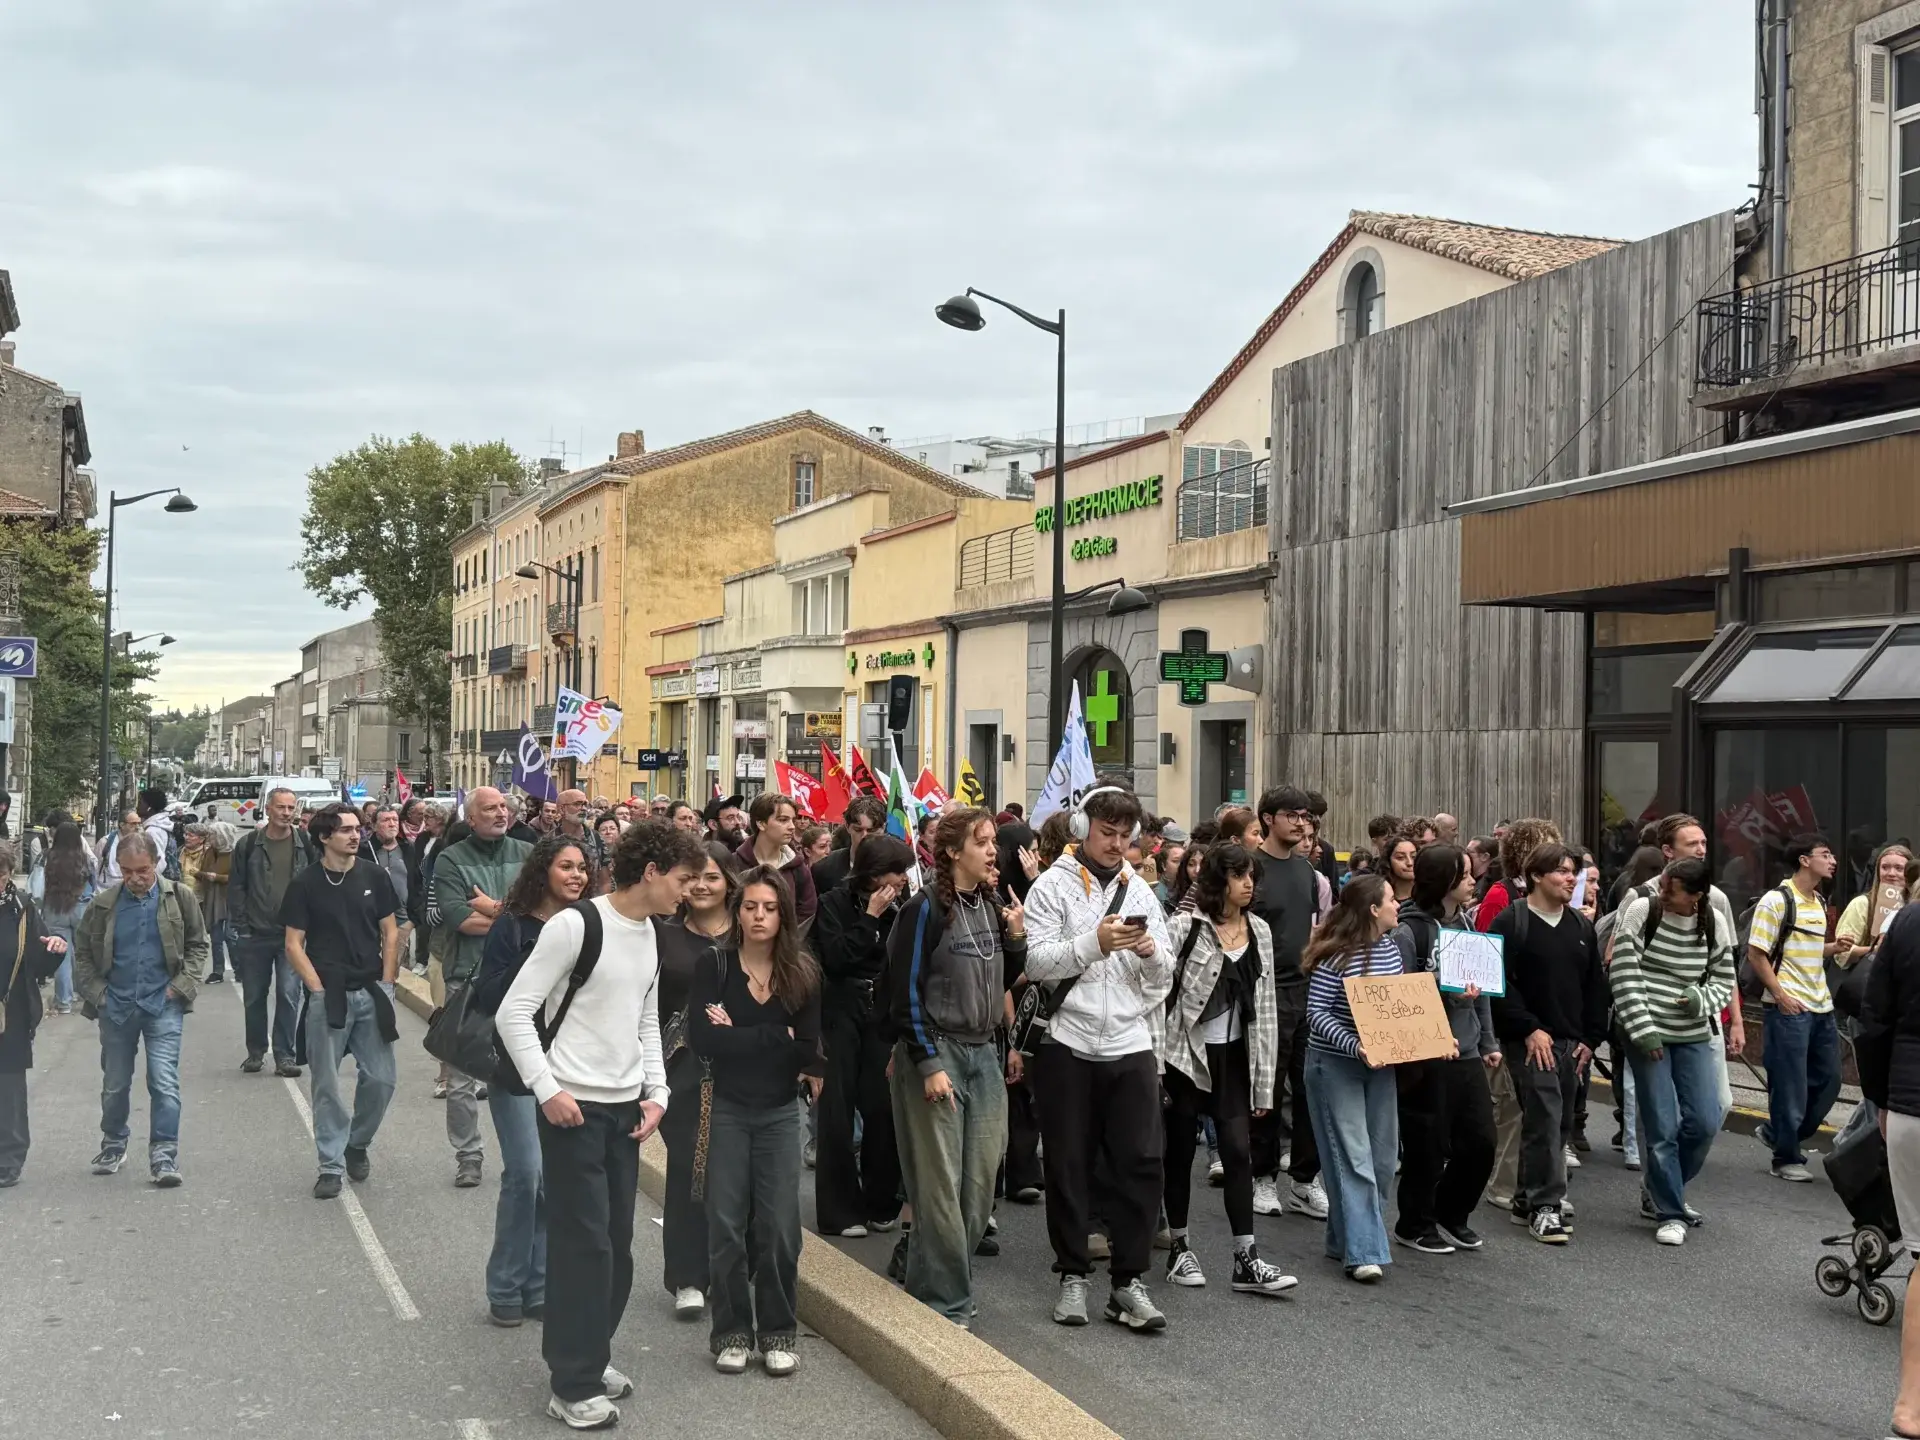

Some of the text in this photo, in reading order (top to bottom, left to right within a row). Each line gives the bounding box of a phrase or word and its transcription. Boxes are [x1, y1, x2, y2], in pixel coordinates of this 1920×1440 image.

[1034, 475, 1162, 533] GRADE PHARMACIE
[1070, 541, 1081, 560] de
[1090, 536, 1116, 556] Gare
[641, 753, 656, 762] GH
[1352, 980, 1433, 1004] 1 PROF POUR
[1372, 998, 1425, 1020] 35 élèves
[1433, 1022, 1446, 1040] 1
